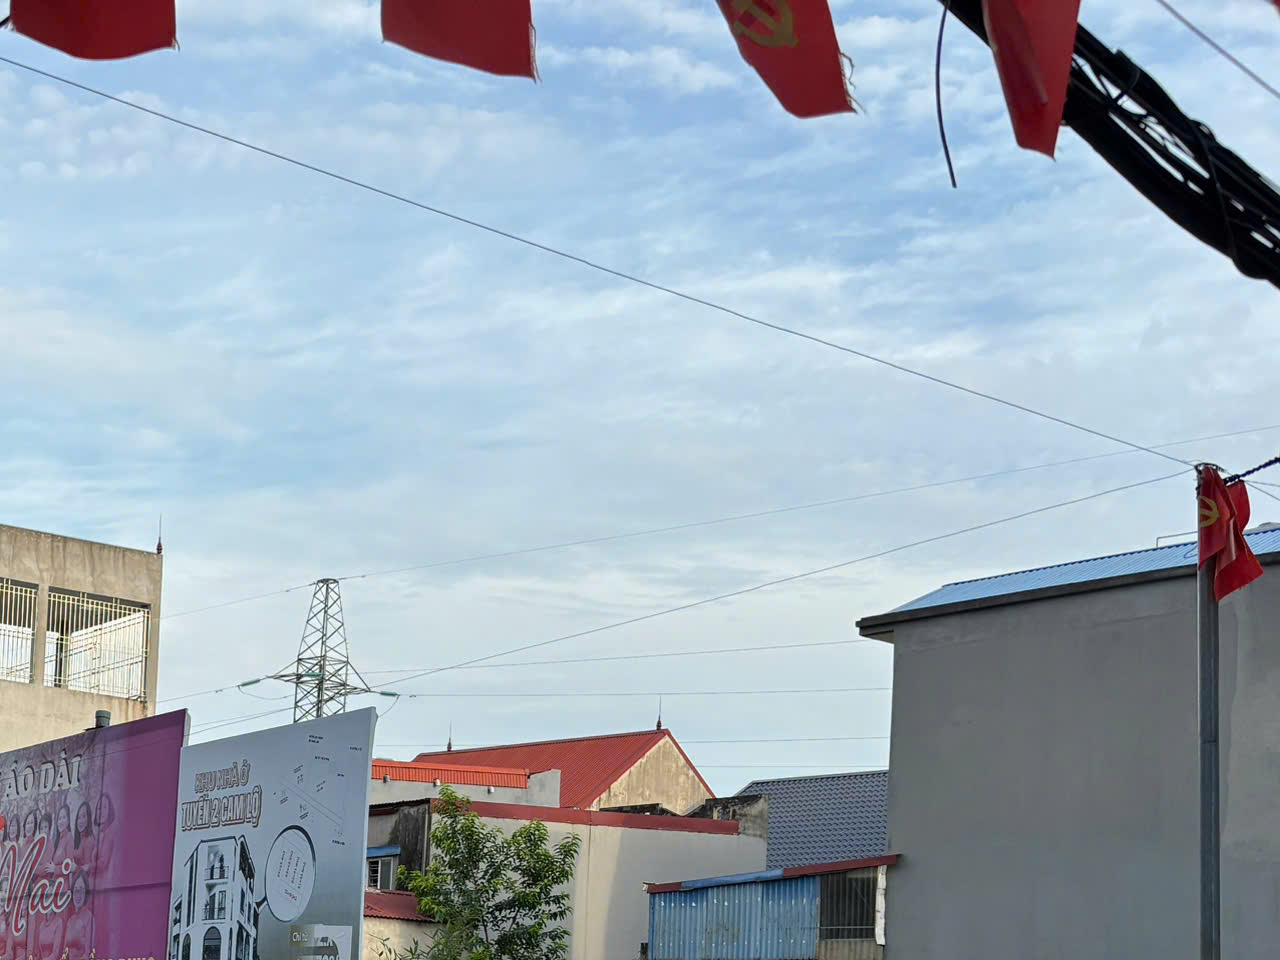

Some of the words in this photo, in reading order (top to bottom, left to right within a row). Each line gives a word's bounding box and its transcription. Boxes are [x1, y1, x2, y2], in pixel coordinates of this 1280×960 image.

[6, 760, 35, 799] ÁO
[40, 749, 83, 793] DÀI
[195, 771, 216, 793] KHU
[217, 761, 239, 790] NHÀ
[240, 759, 251, 786] Ở
[182, 793, 210, 831] TUYẾN
[211, 798, 220, 827] 2
[221, 793, 246, 826] CAM
[246, 784, 262, 828] LỘ
